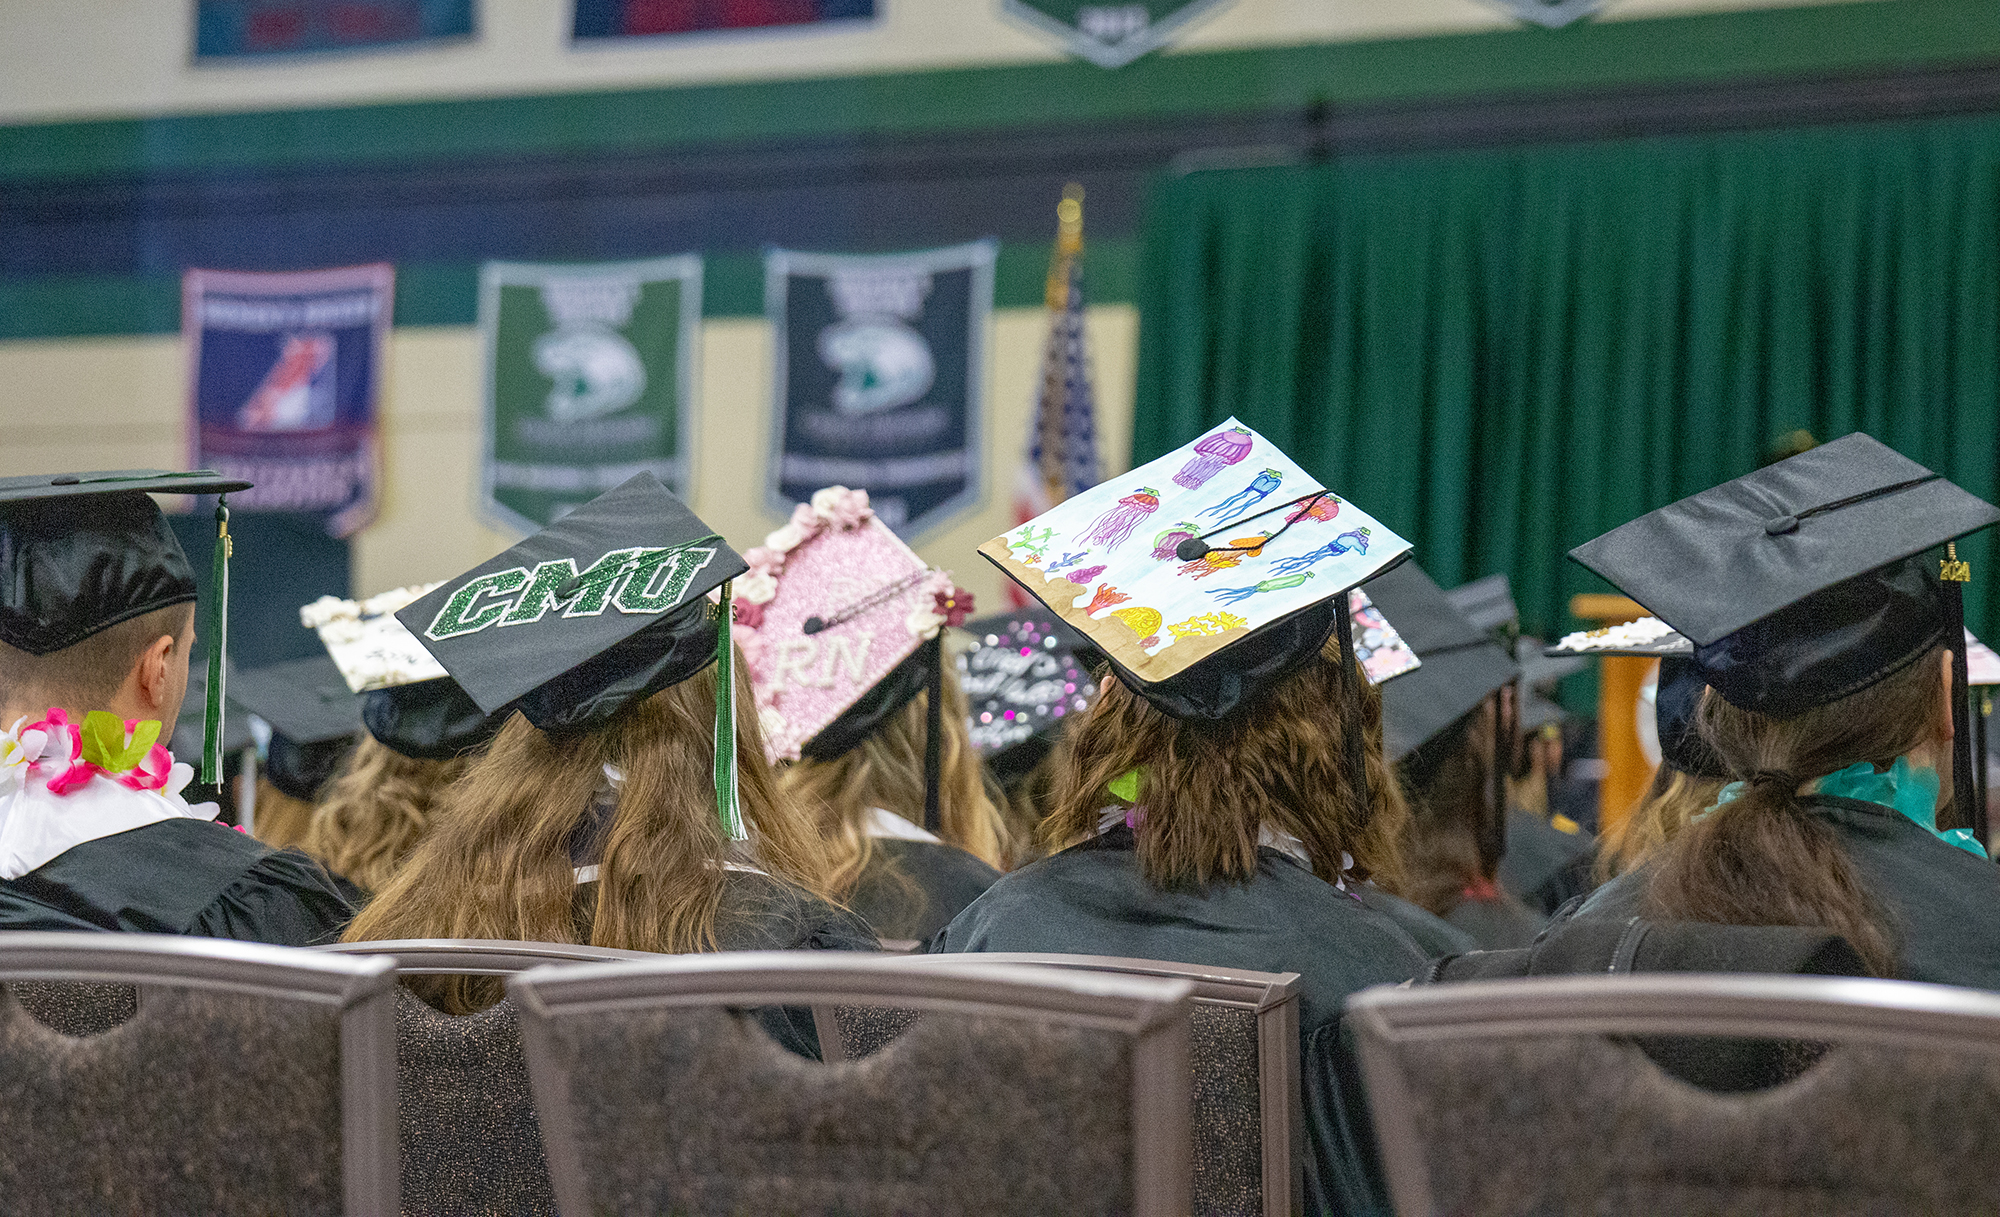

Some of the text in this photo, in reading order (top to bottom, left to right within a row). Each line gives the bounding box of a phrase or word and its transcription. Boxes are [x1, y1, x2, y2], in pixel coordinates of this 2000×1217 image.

[424, 547, 717, 641] CMU
[1940, 560, 1971, 582] 2024
[767, 631, 874, 689] RN
